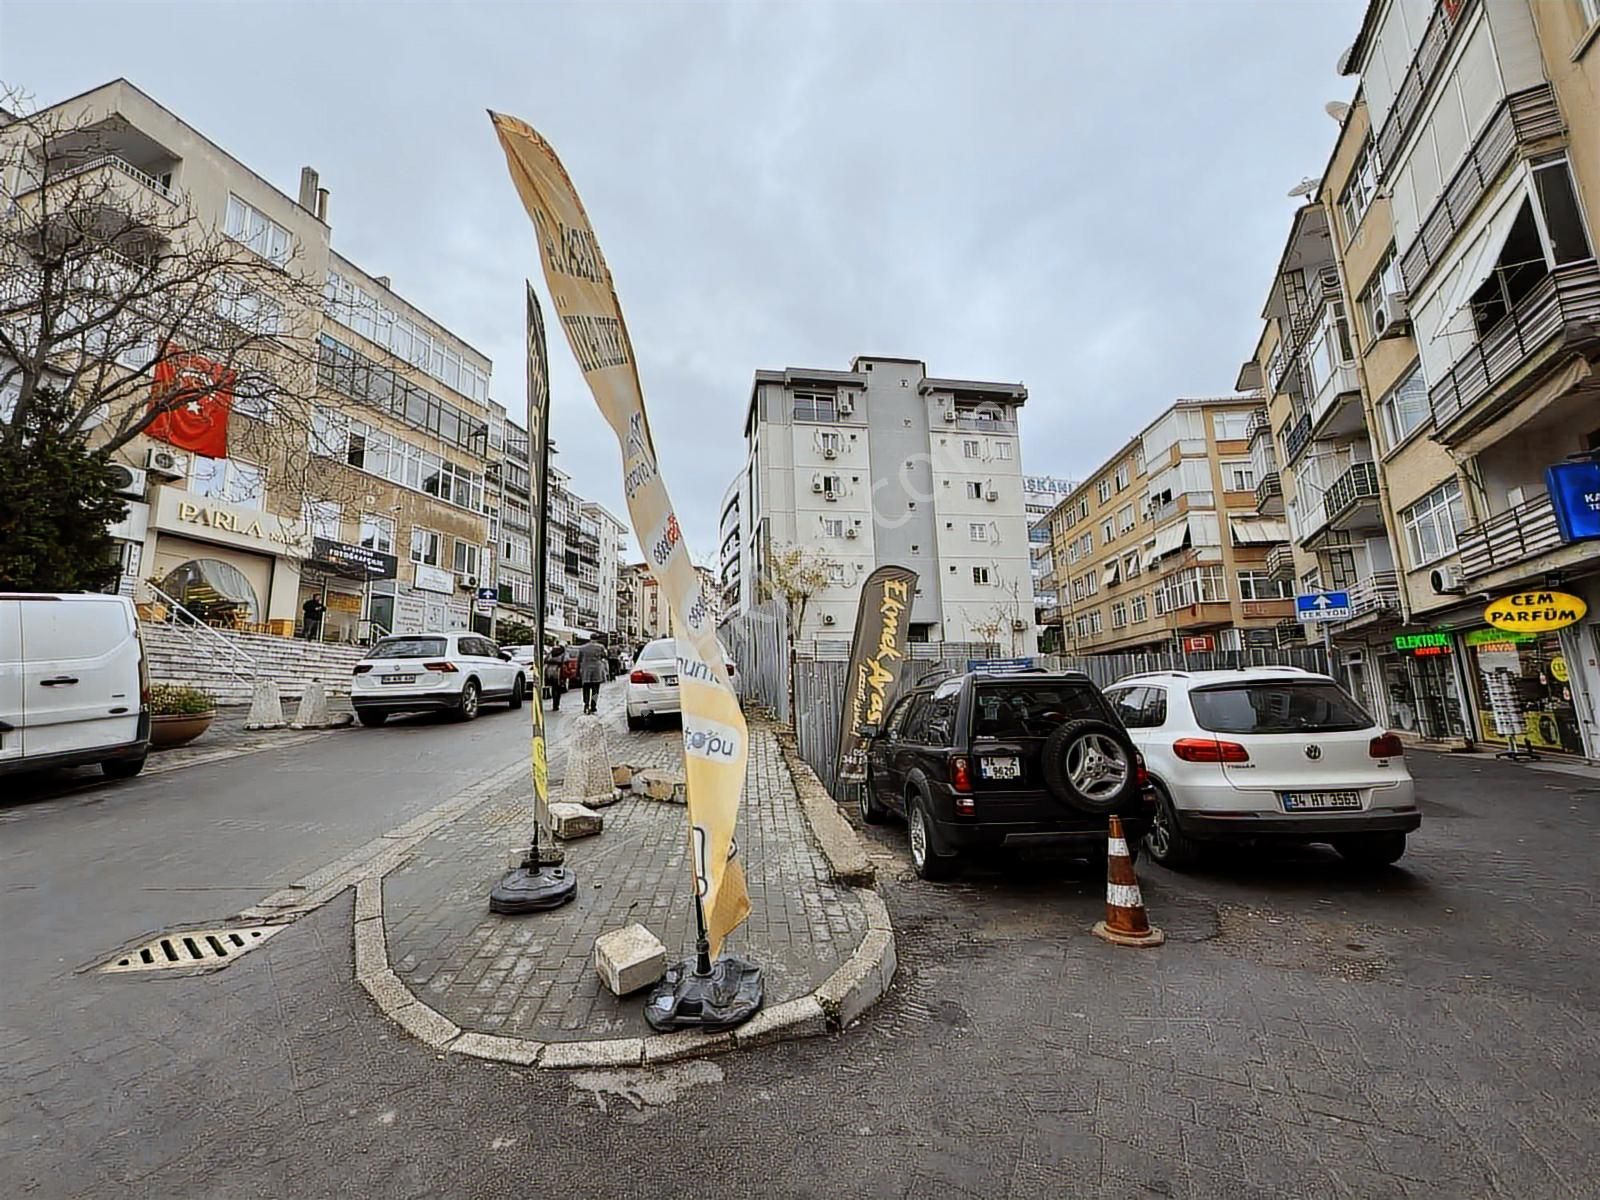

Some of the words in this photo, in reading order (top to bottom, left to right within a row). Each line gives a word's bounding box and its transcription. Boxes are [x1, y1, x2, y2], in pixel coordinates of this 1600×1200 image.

[178, 501, 264, 539] PARLA
[1511, 593, 1554, 606] CEM
[876, 579, 908, 661] Ekmek
[1490, 608, 1576, 622] PARFÜM
[1291, 793, 1306, 807] 34
[1310, 793, 1325, 806] HT
